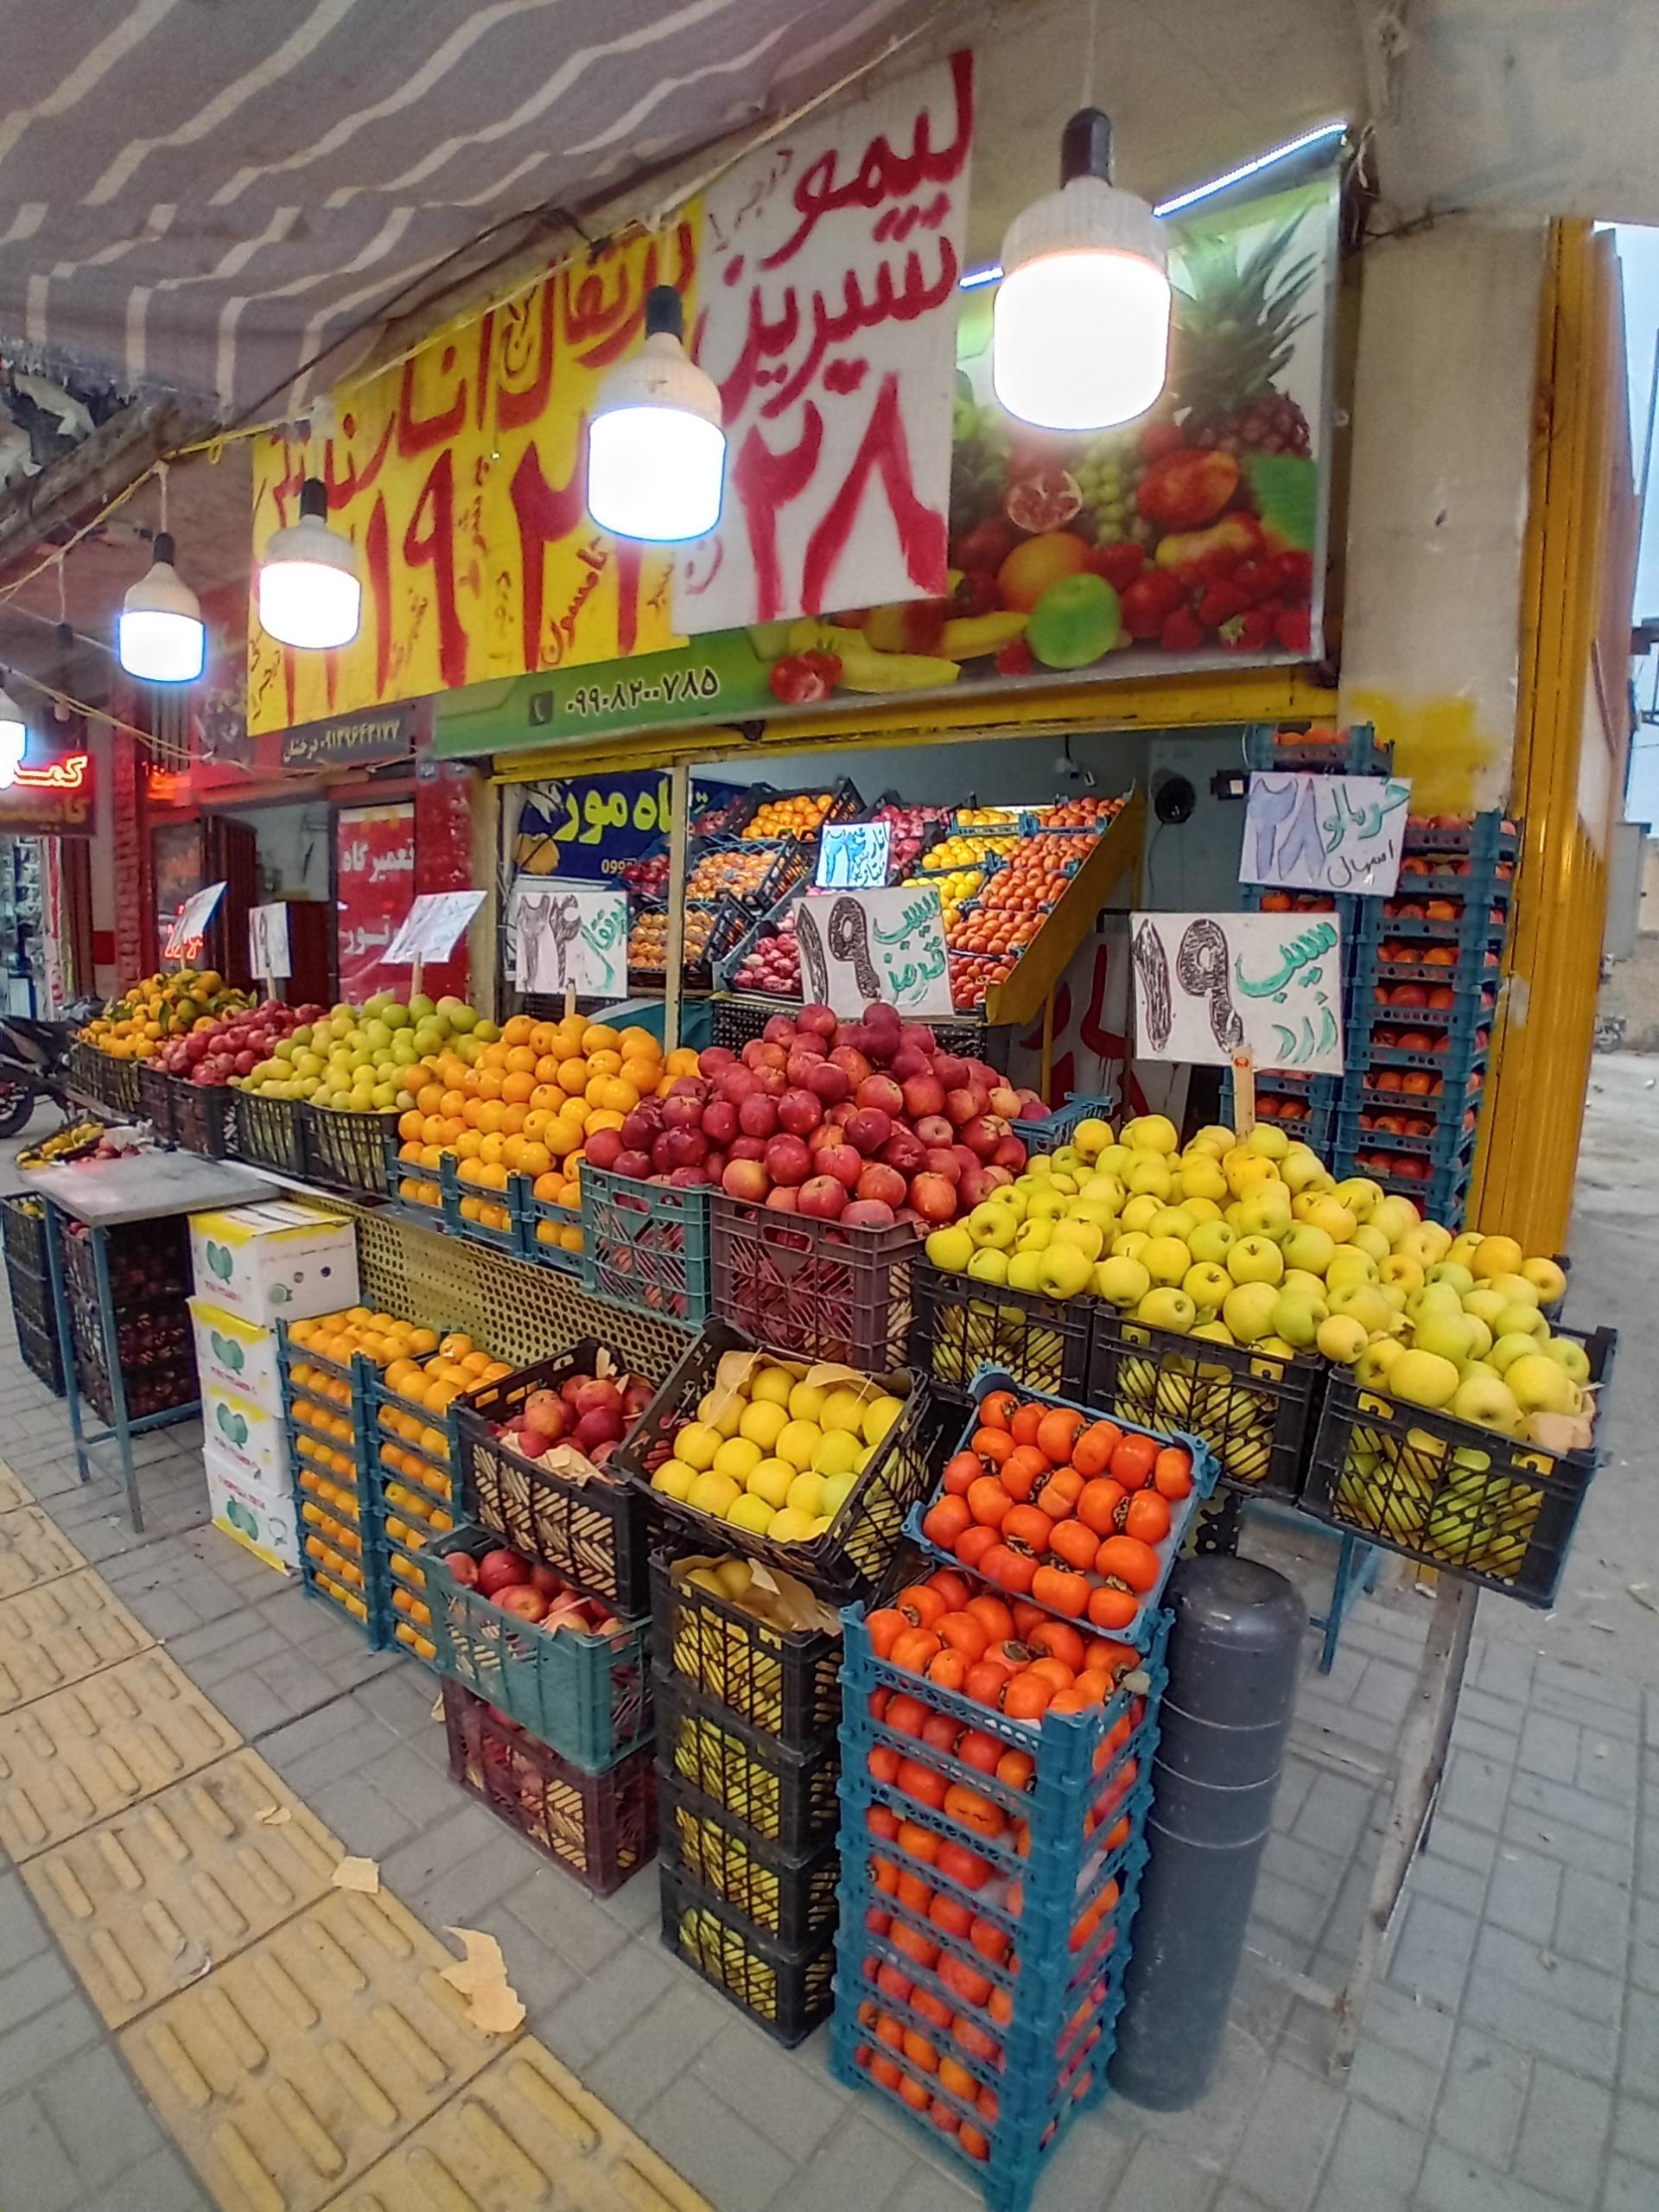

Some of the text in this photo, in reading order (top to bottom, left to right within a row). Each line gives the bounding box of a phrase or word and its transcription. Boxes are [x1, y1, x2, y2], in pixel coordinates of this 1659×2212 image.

[759, 48, 974, 272] لیمو
[731, 372, 949, 624] ۲۸
[565, 665, 720, 716] ۰۹۹۰۸۲۰۰۷۸۵
[1248, 778, 1326, 880] ۲۸
[1323, 777, 1410, 855] خرمالو
[518, 894, 582, 992] ۲۴
[797, 896, 881, 1006] ۱۹
[873, 890, 942, 950] سیب
[1235, 921, 1338, 1004] سیب
[883, 936, 946, 1006] قرمز
[1131, 918, 1244, 1054] ۱۹
[1272, 991, 1339, 1065] زرد
